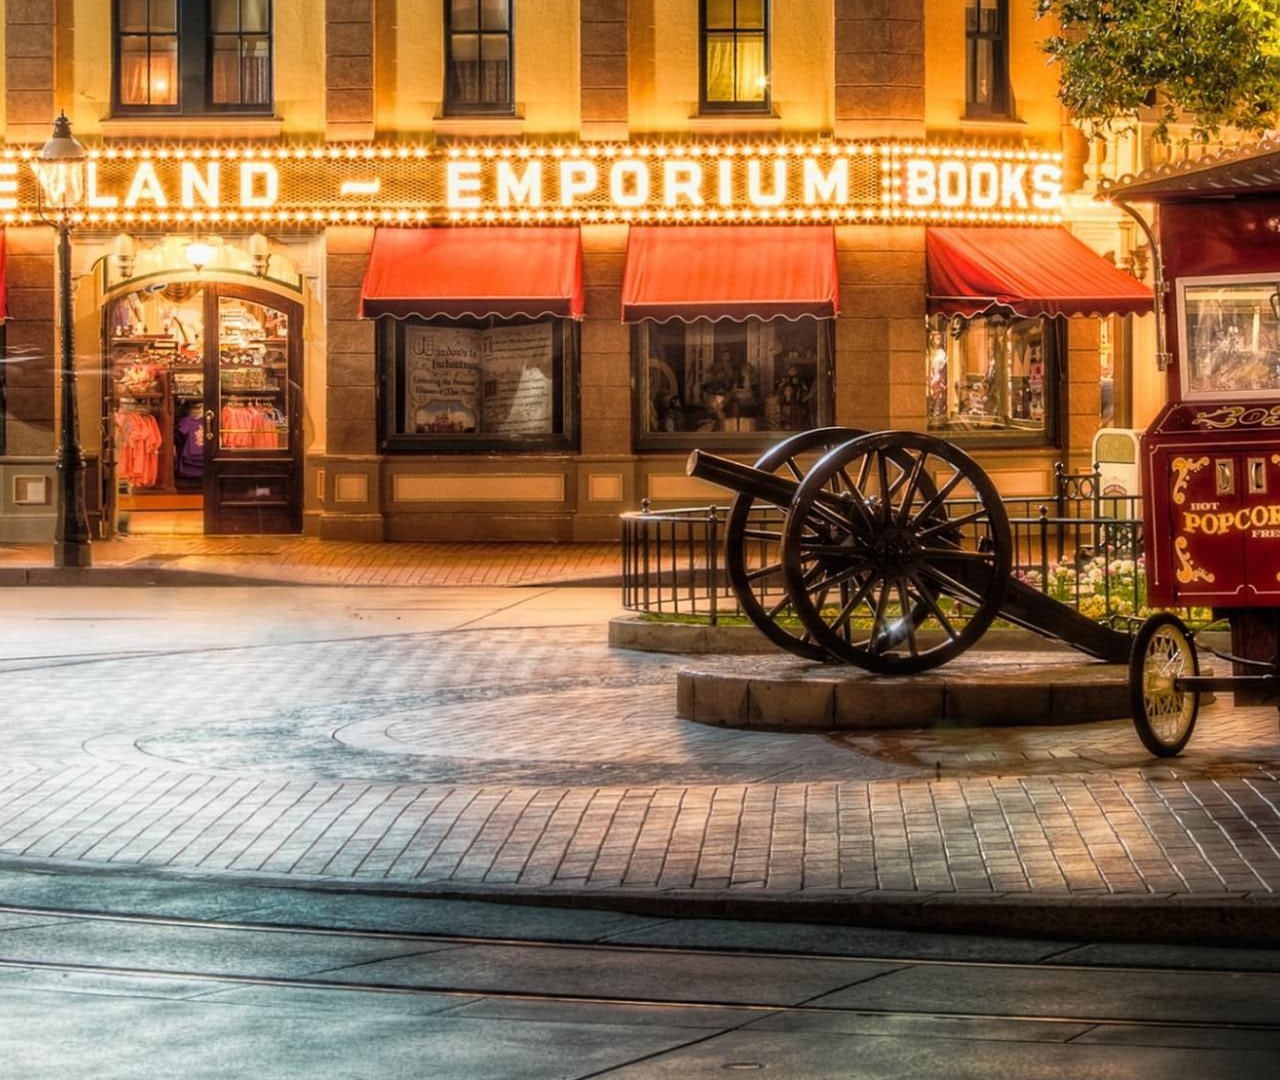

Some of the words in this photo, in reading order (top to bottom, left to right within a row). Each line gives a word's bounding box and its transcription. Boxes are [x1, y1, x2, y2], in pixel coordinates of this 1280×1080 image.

[447, 158, 849, 208] EMPORIUM
[906, 160, 1063, 209] BOOKS
[1190, 502, 1220, 511] HOT
